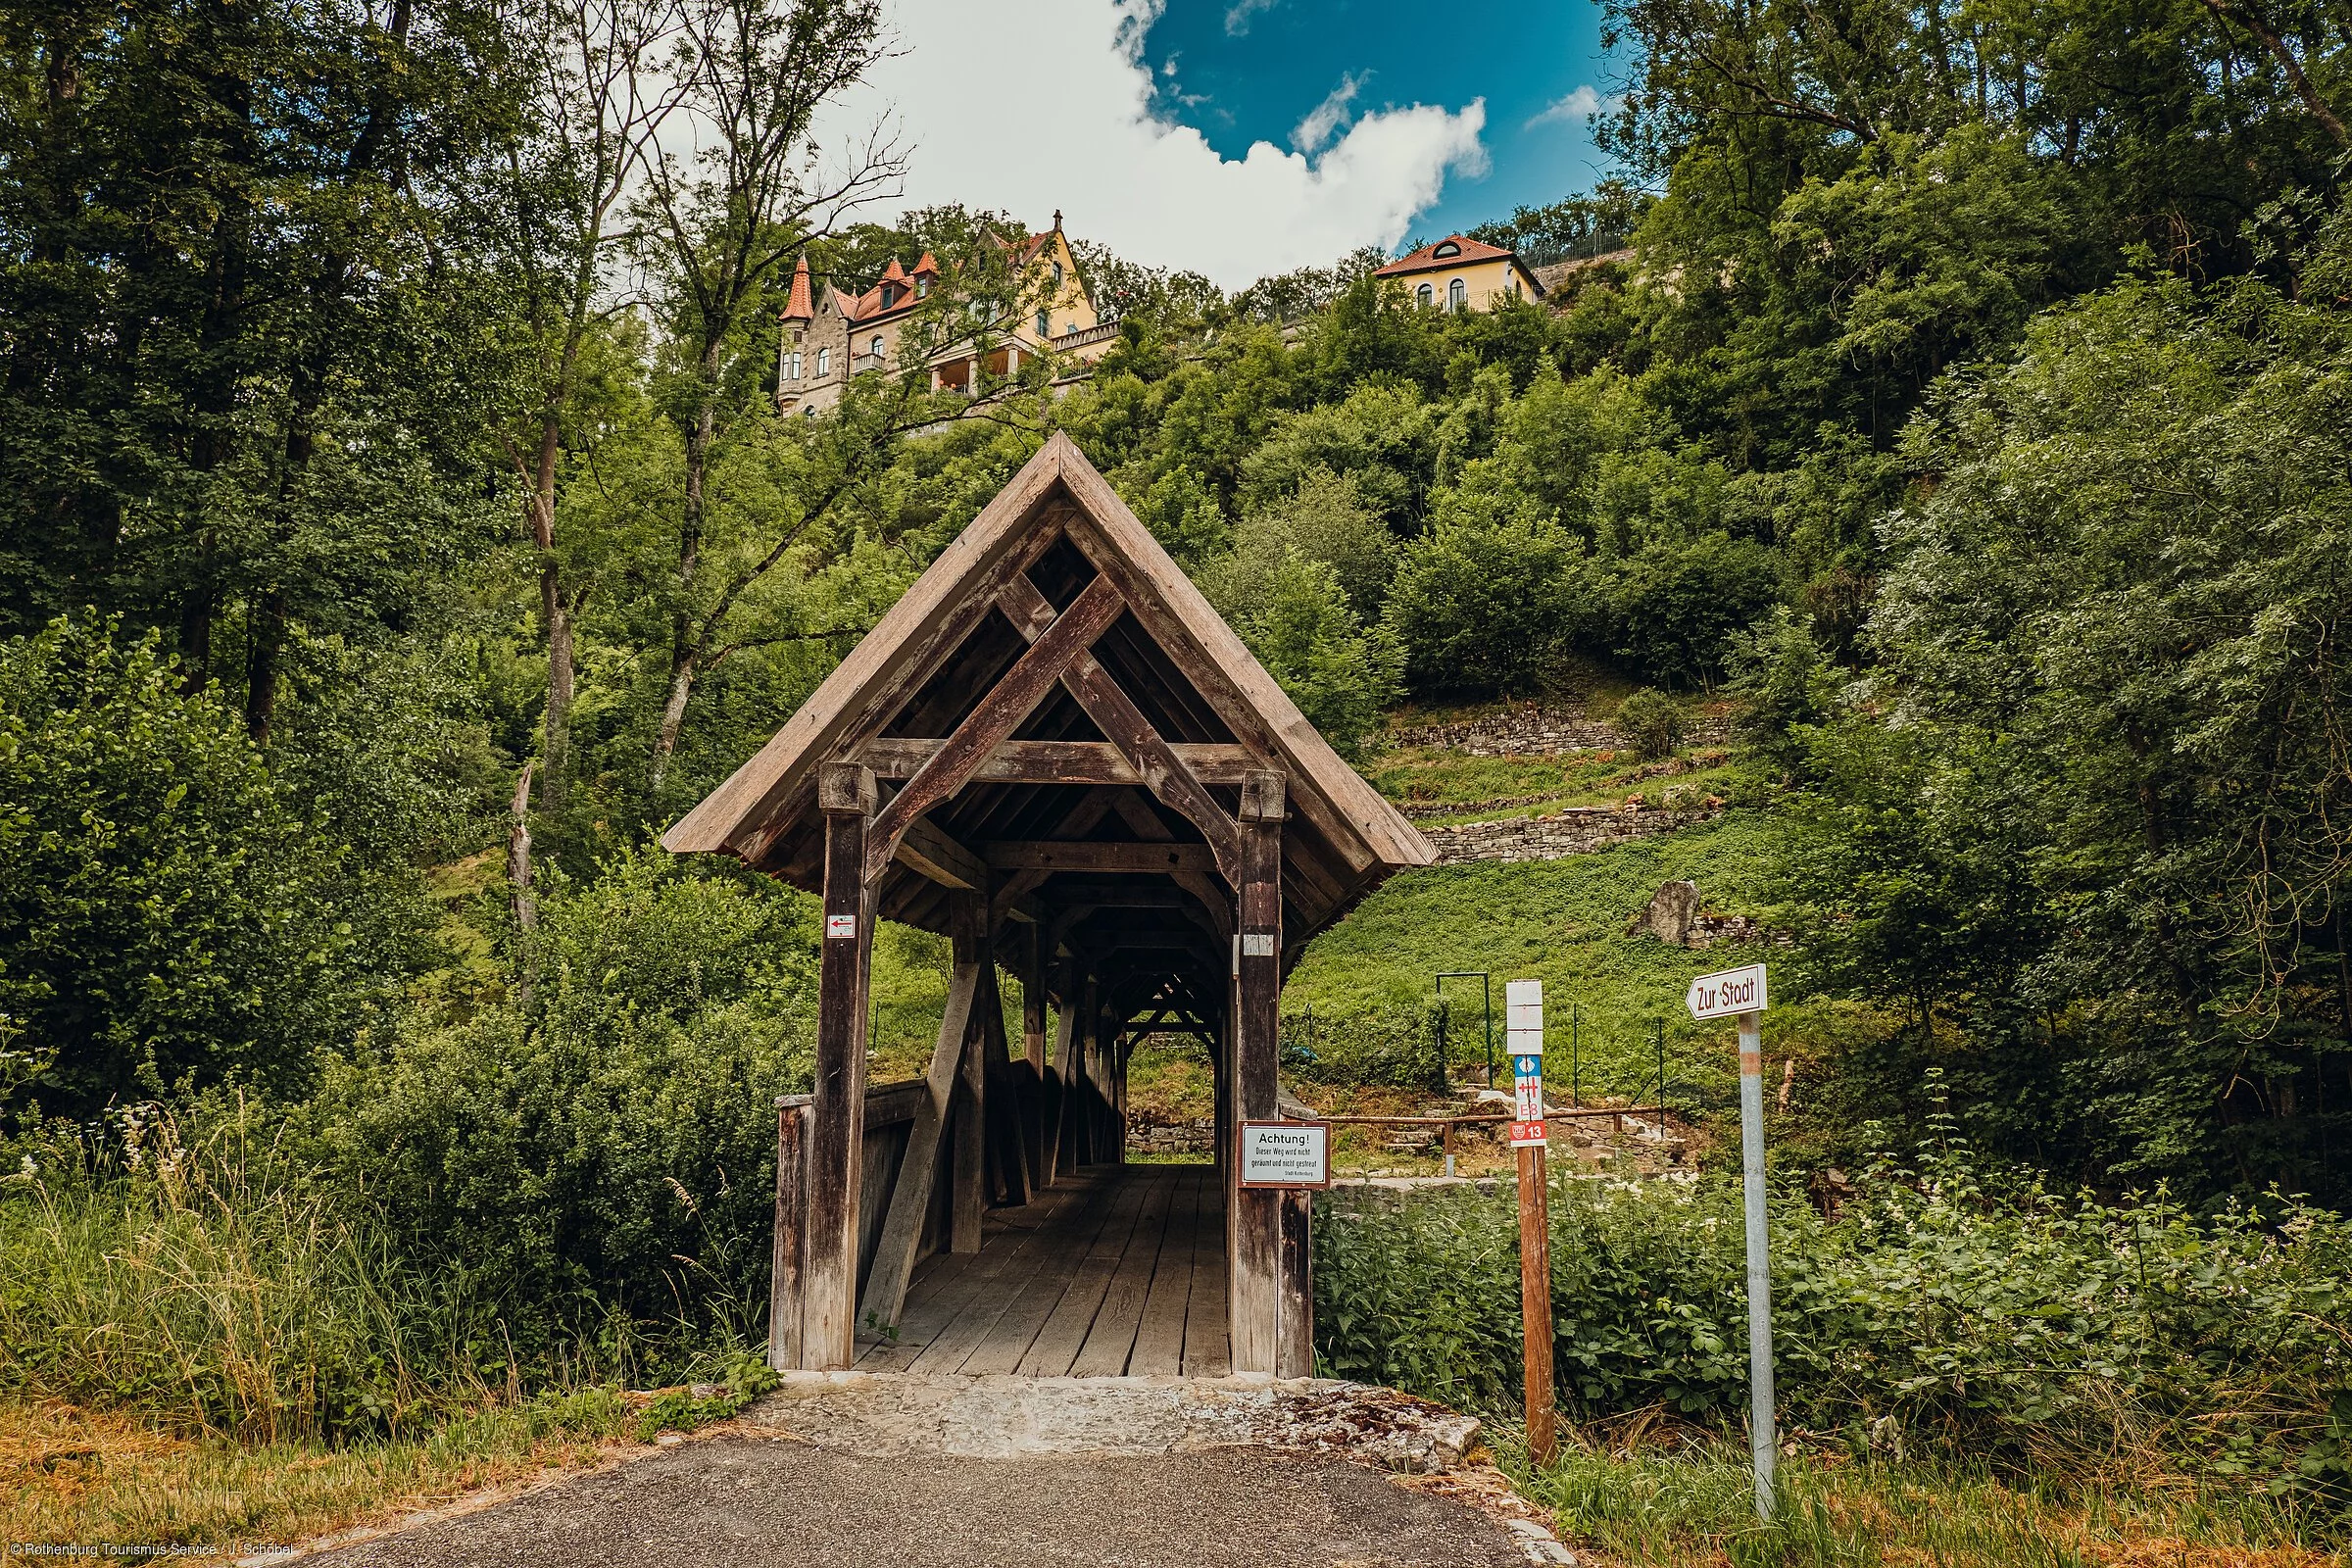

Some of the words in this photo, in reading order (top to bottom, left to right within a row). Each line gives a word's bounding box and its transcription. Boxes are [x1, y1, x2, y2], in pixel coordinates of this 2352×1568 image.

[1697, 986, 1716, 1010] Zur
[1722, 978, 1754, 1006] Stadt
[1520, 1103, 1538, 1115] E8
[1528, 1125, 1542, 1138] 13
[1258, 1133, 1309, 1146] Achtung!
[1273, 1148, 1284, 1156] Weg
